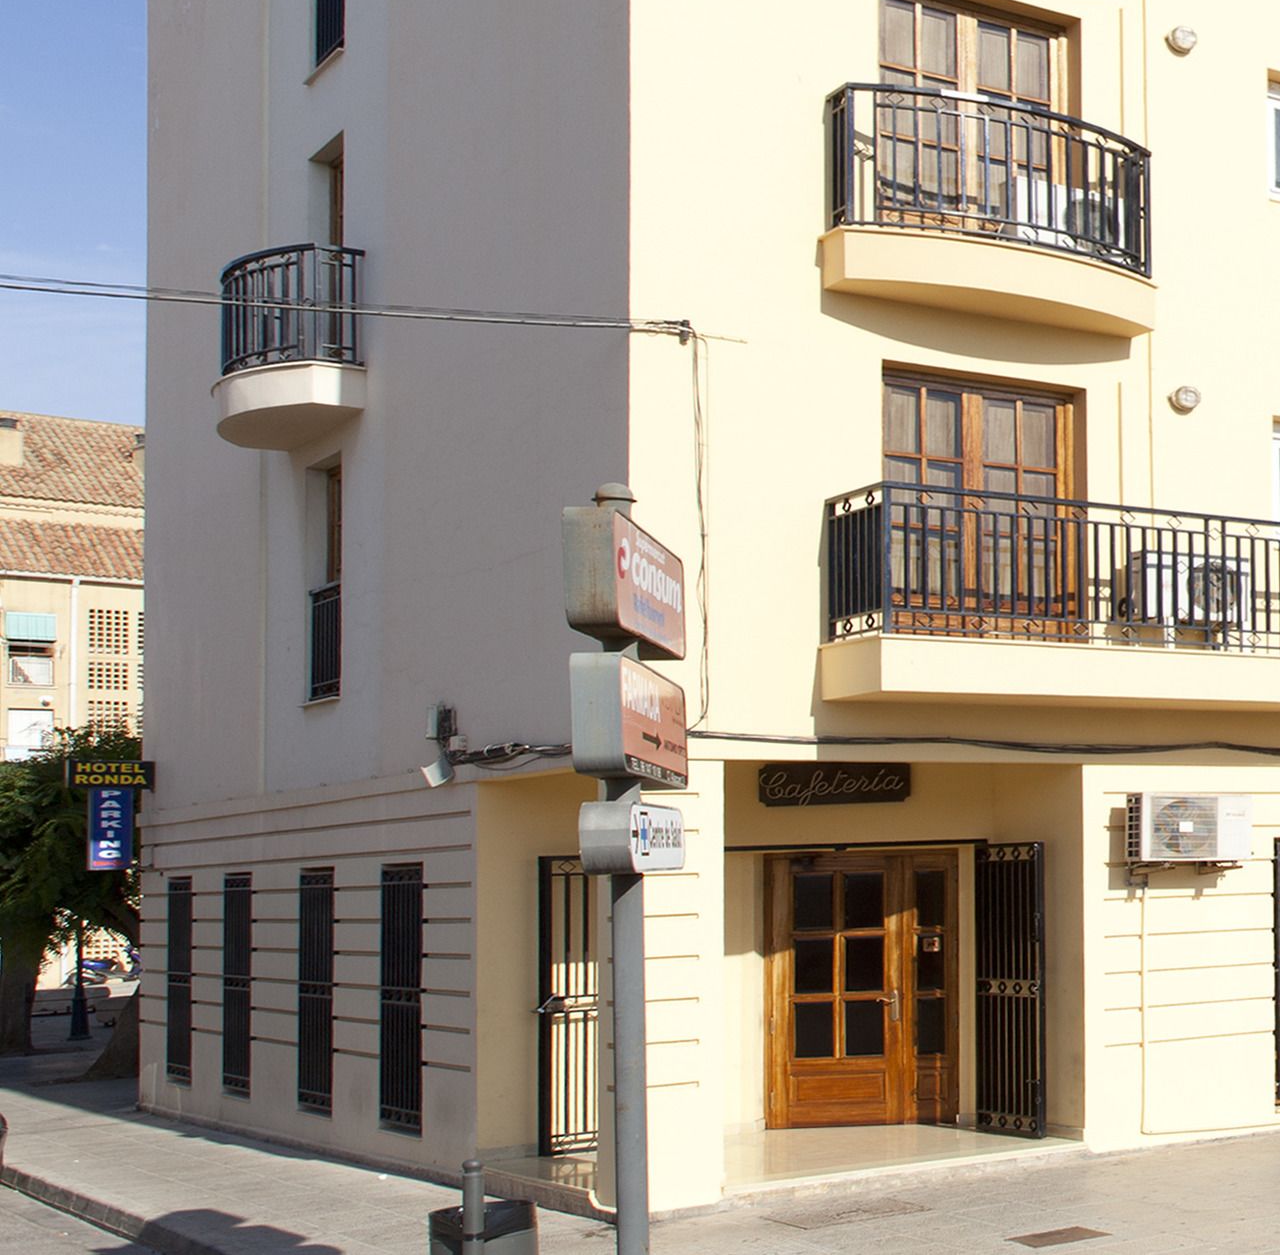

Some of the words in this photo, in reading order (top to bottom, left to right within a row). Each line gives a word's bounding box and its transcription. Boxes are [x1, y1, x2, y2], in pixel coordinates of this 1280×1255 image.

[74, 774, 147, 785] RONDA
[75, 762, 145, 773] HOTEL
[759, 769, 904, 807] Cafetería
[98, 790, 122, 859] PARKING
